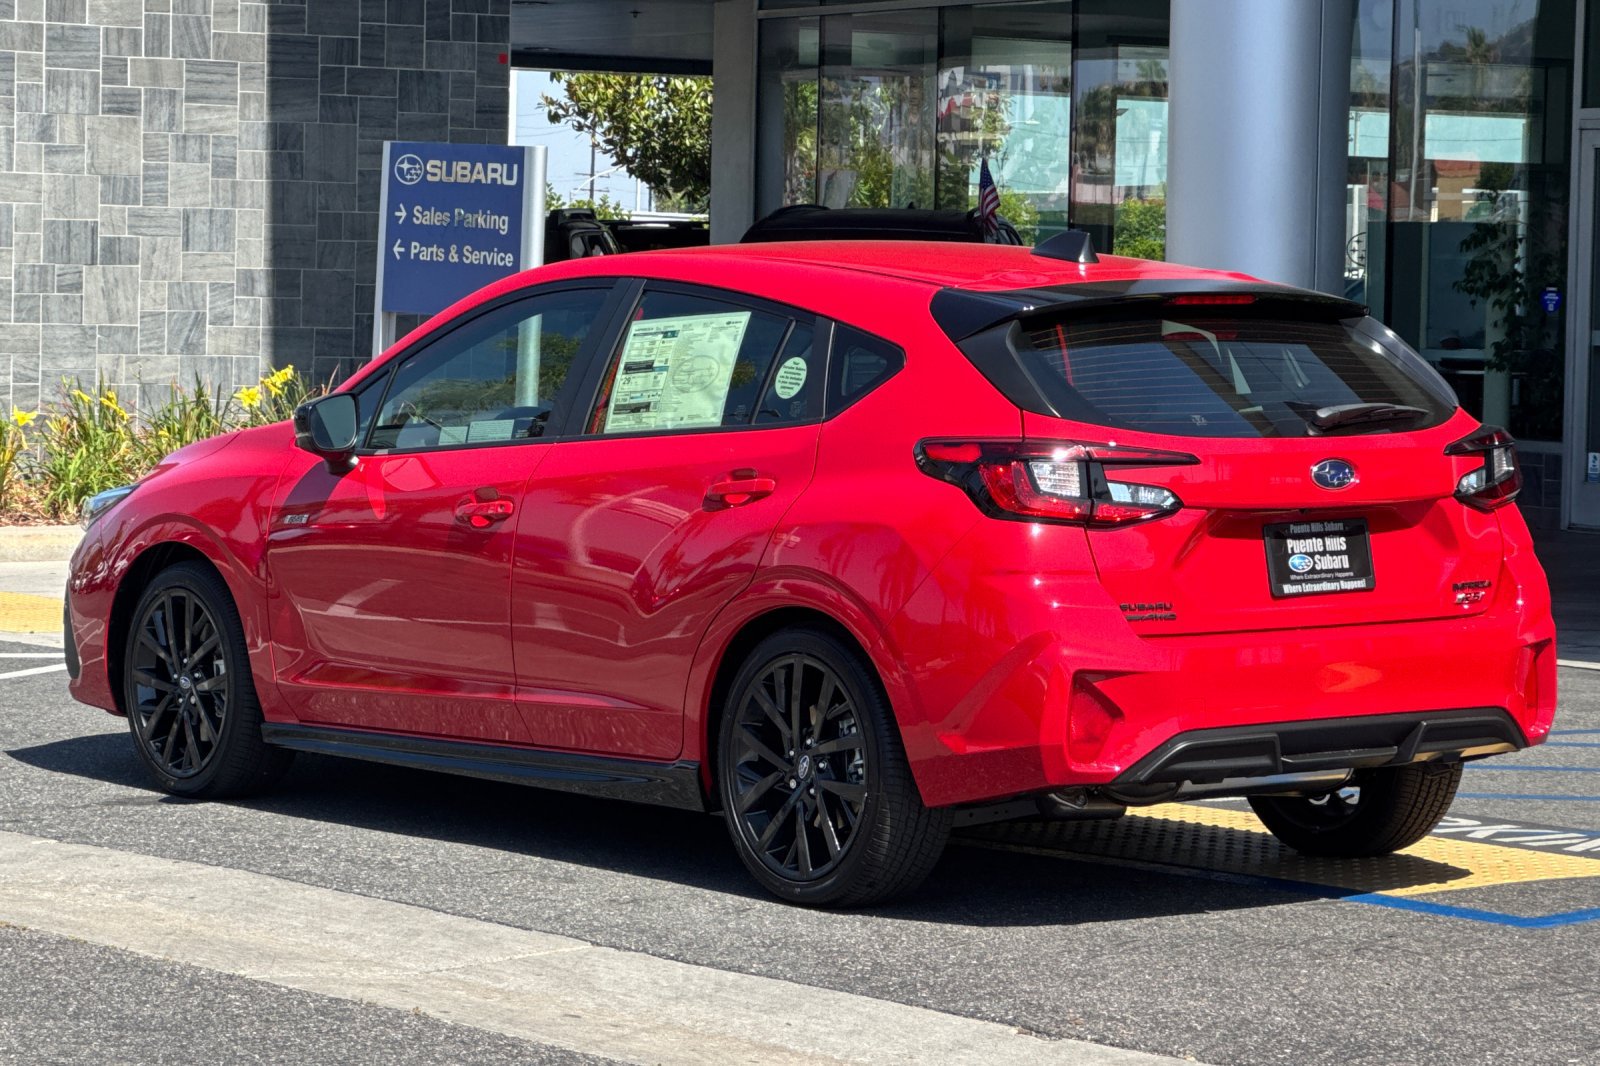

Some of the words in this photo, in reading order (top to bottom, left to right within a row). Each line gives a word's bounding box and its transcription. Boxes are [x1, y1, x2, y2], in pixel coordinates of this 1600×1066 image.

[426, 160, 518, 186] SUBARU
[413, 205, 450, 226] Sales
[454, 208, 508, 235] Parking
[410, 242, 444, 262] Parts
[448, 244, 459, 263] &
[463, 245, 513, 267] Service
[1290, 524, 1310, 534] Puente
[1310, 522, 1324, 532] Hills
[1324, 522, 1344, 532] Subaru
[1286, 537, 1324, 554] Puente
[1325, 536, 1347, 551] Hills
[1314, 554, 1350, 570] Subaru
[1304, 572, 1334, 580] Extraordinary
[1283, 584, 1302, 594] Where
[1302, 581, 1340, 593] Extraordinary
[1120, 602, 1173, 612] SUBARU
